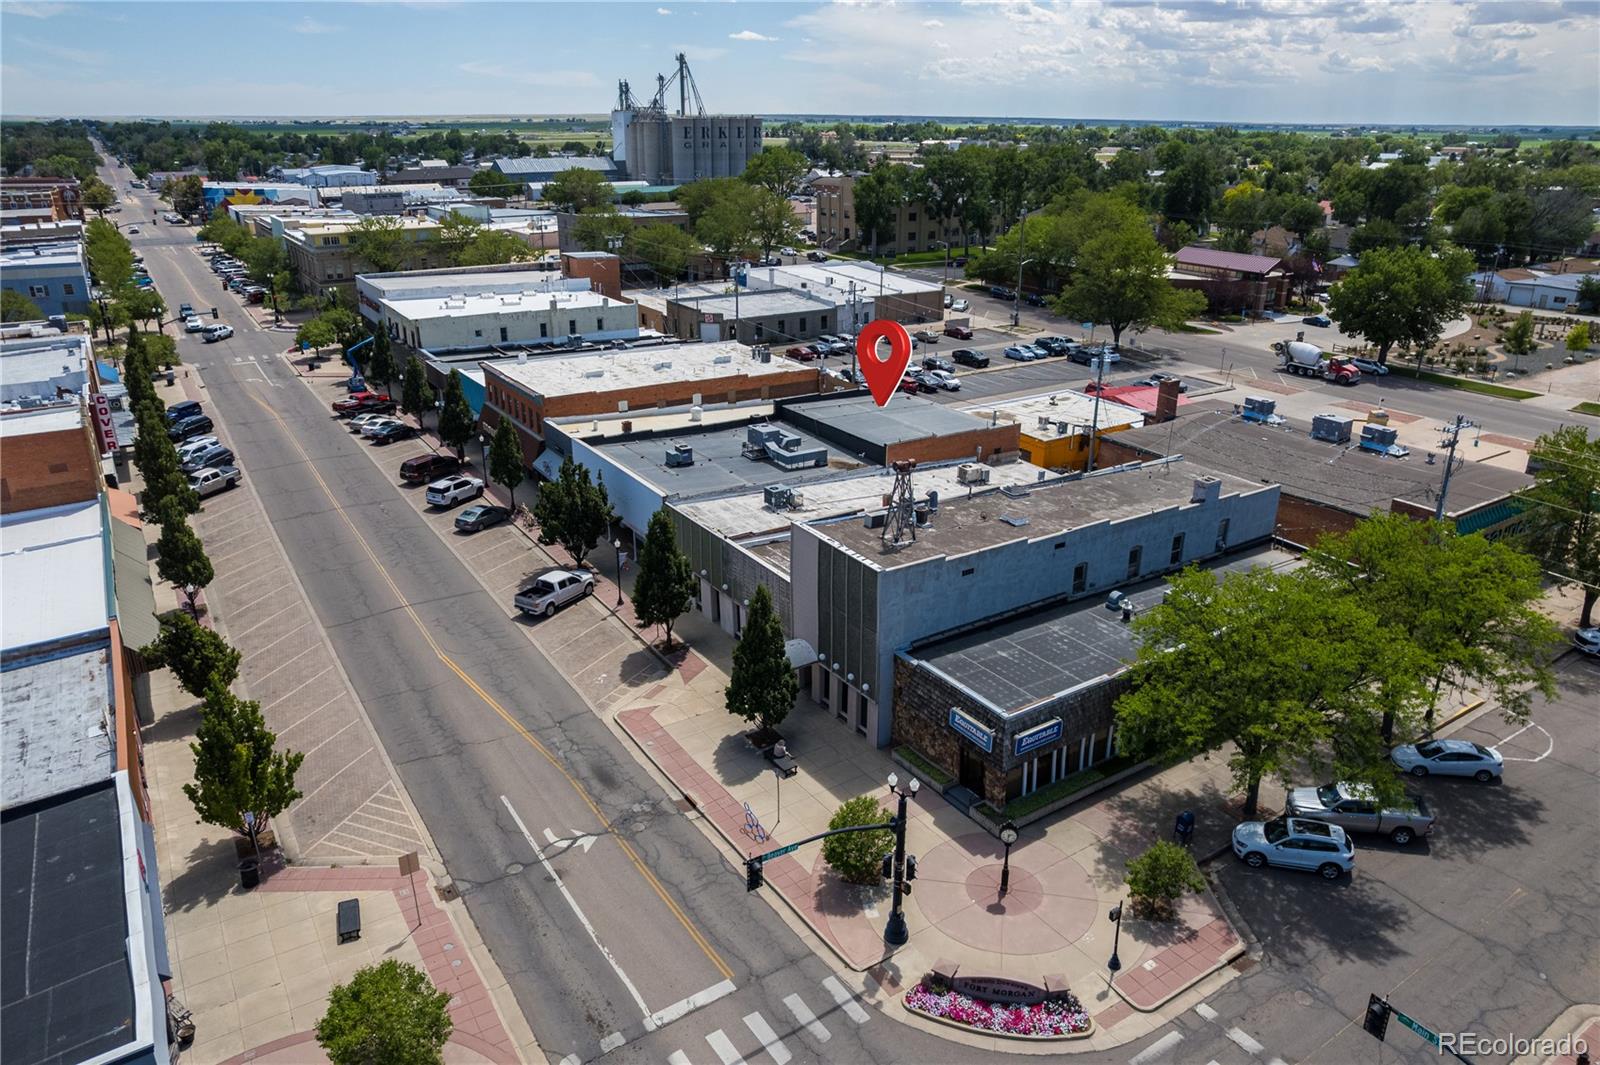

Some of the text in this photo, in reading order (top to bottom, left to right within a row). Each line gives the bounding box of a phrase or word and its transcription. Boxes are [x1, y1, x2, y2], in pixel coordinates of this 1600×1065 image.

[683, 126, 762, 139] ERKER
[683, 141, 761, 149] GRAIN
[95, 395, 117, 450] COVER
[963, 981, 988, 993] FORT
[992, 987, 1036, 998] MORGAN
[1411, 1022, 1430, 1040] Main
